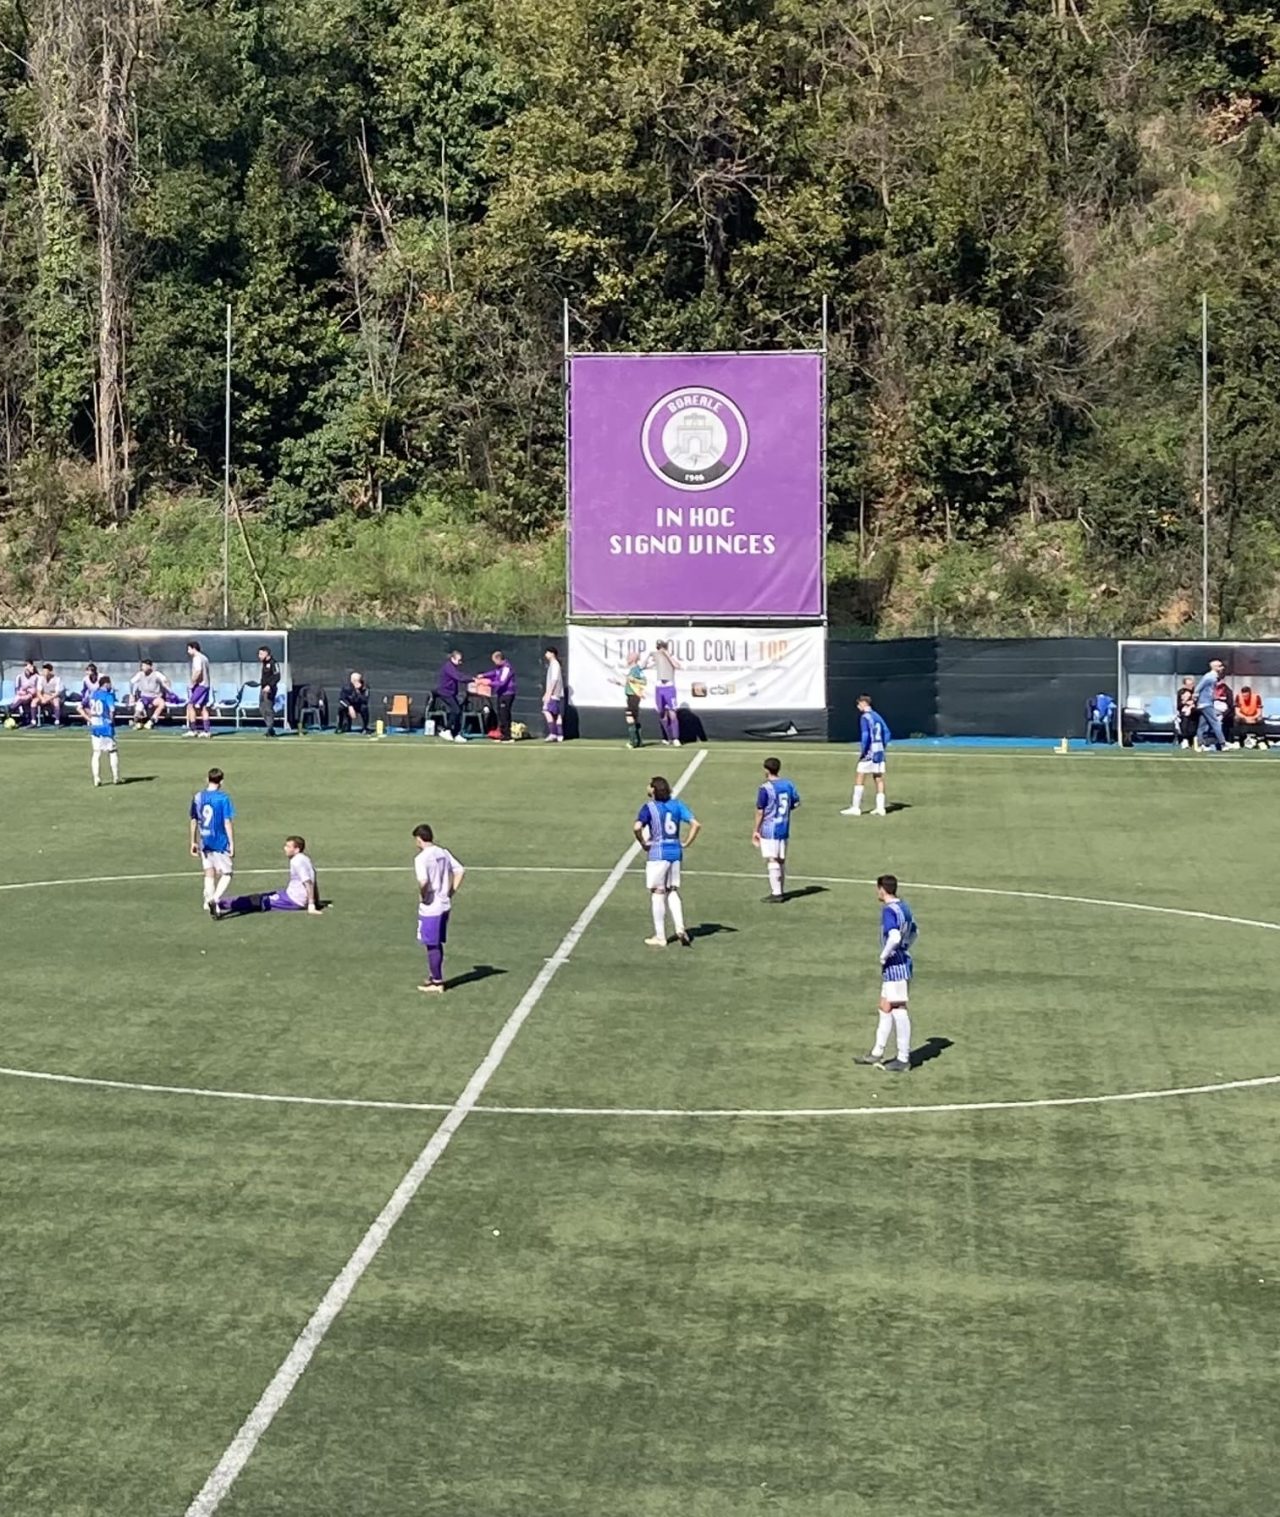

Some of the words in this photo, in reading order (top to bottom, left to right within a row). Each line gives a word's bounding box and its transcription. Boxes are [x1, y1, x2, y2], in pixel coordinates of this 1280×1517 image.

[666, 394, 724, 414] BOREALE
[656, 507, 682, 528] IN
[689, 507, 736, 528] HOC
[609, 534, 681, 555] SIGNO
[658, 639, 695, 662] OLO
[704, 639, 736, 662] CON
[202, 803, 214, 827] 9
[664, 812, 677, 835] 6
[436, 857, 447, 893] 7
